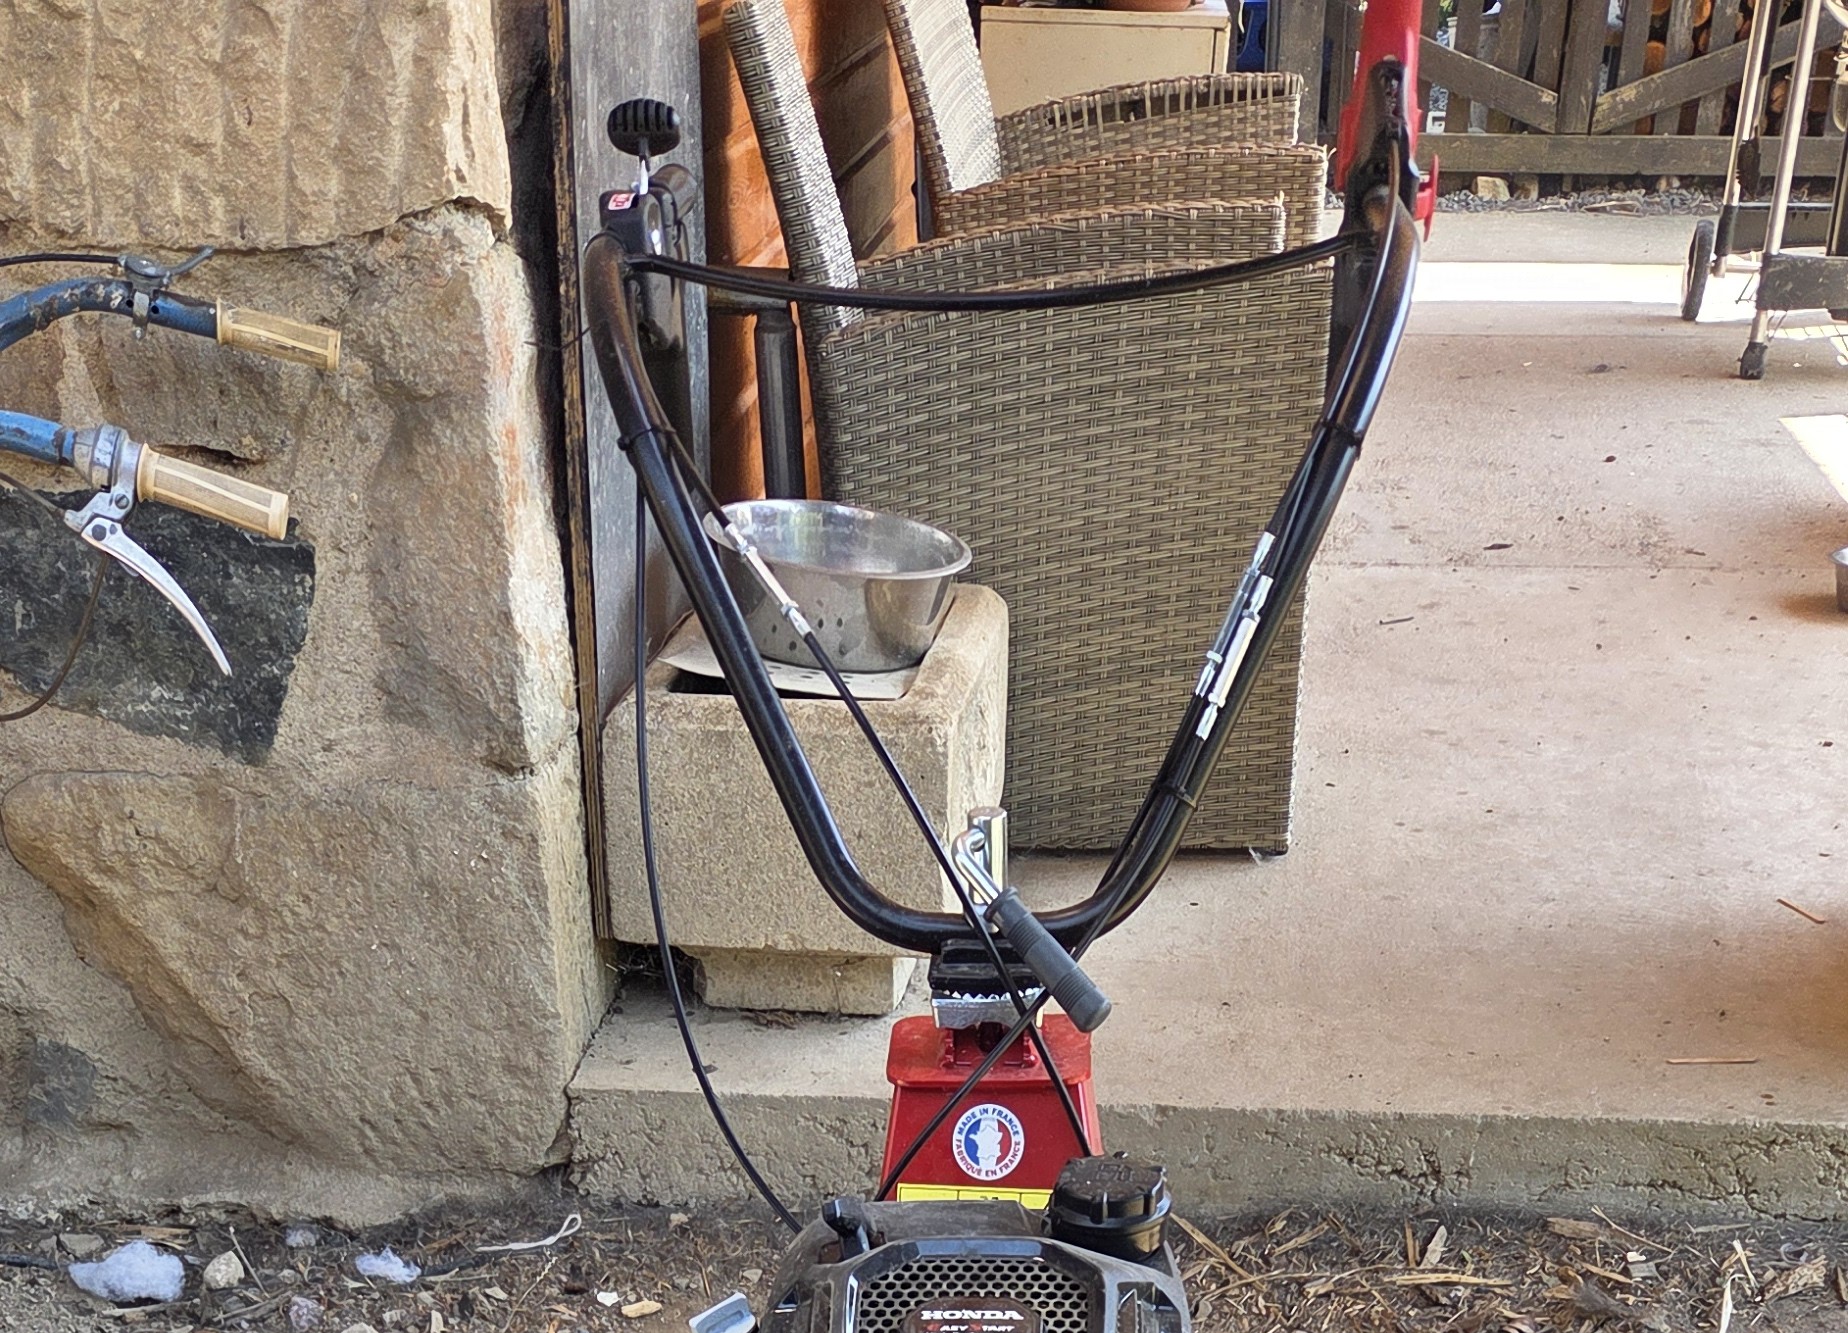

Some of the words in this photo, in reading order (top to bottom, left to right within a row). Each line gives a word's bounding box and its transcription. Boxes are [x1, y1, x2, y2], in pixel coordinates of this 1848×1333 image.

[957, 1111, 977, 1136] MADE
[979, 1107, 989, 1117] IN
[992, 1108, 1020, 1137] FRANCE
[985, 1169, 998, 1178] EN
[1000, 1140, 1021, 1175] FRANCE
[920, 1310, 1024, 1320] HONDA
